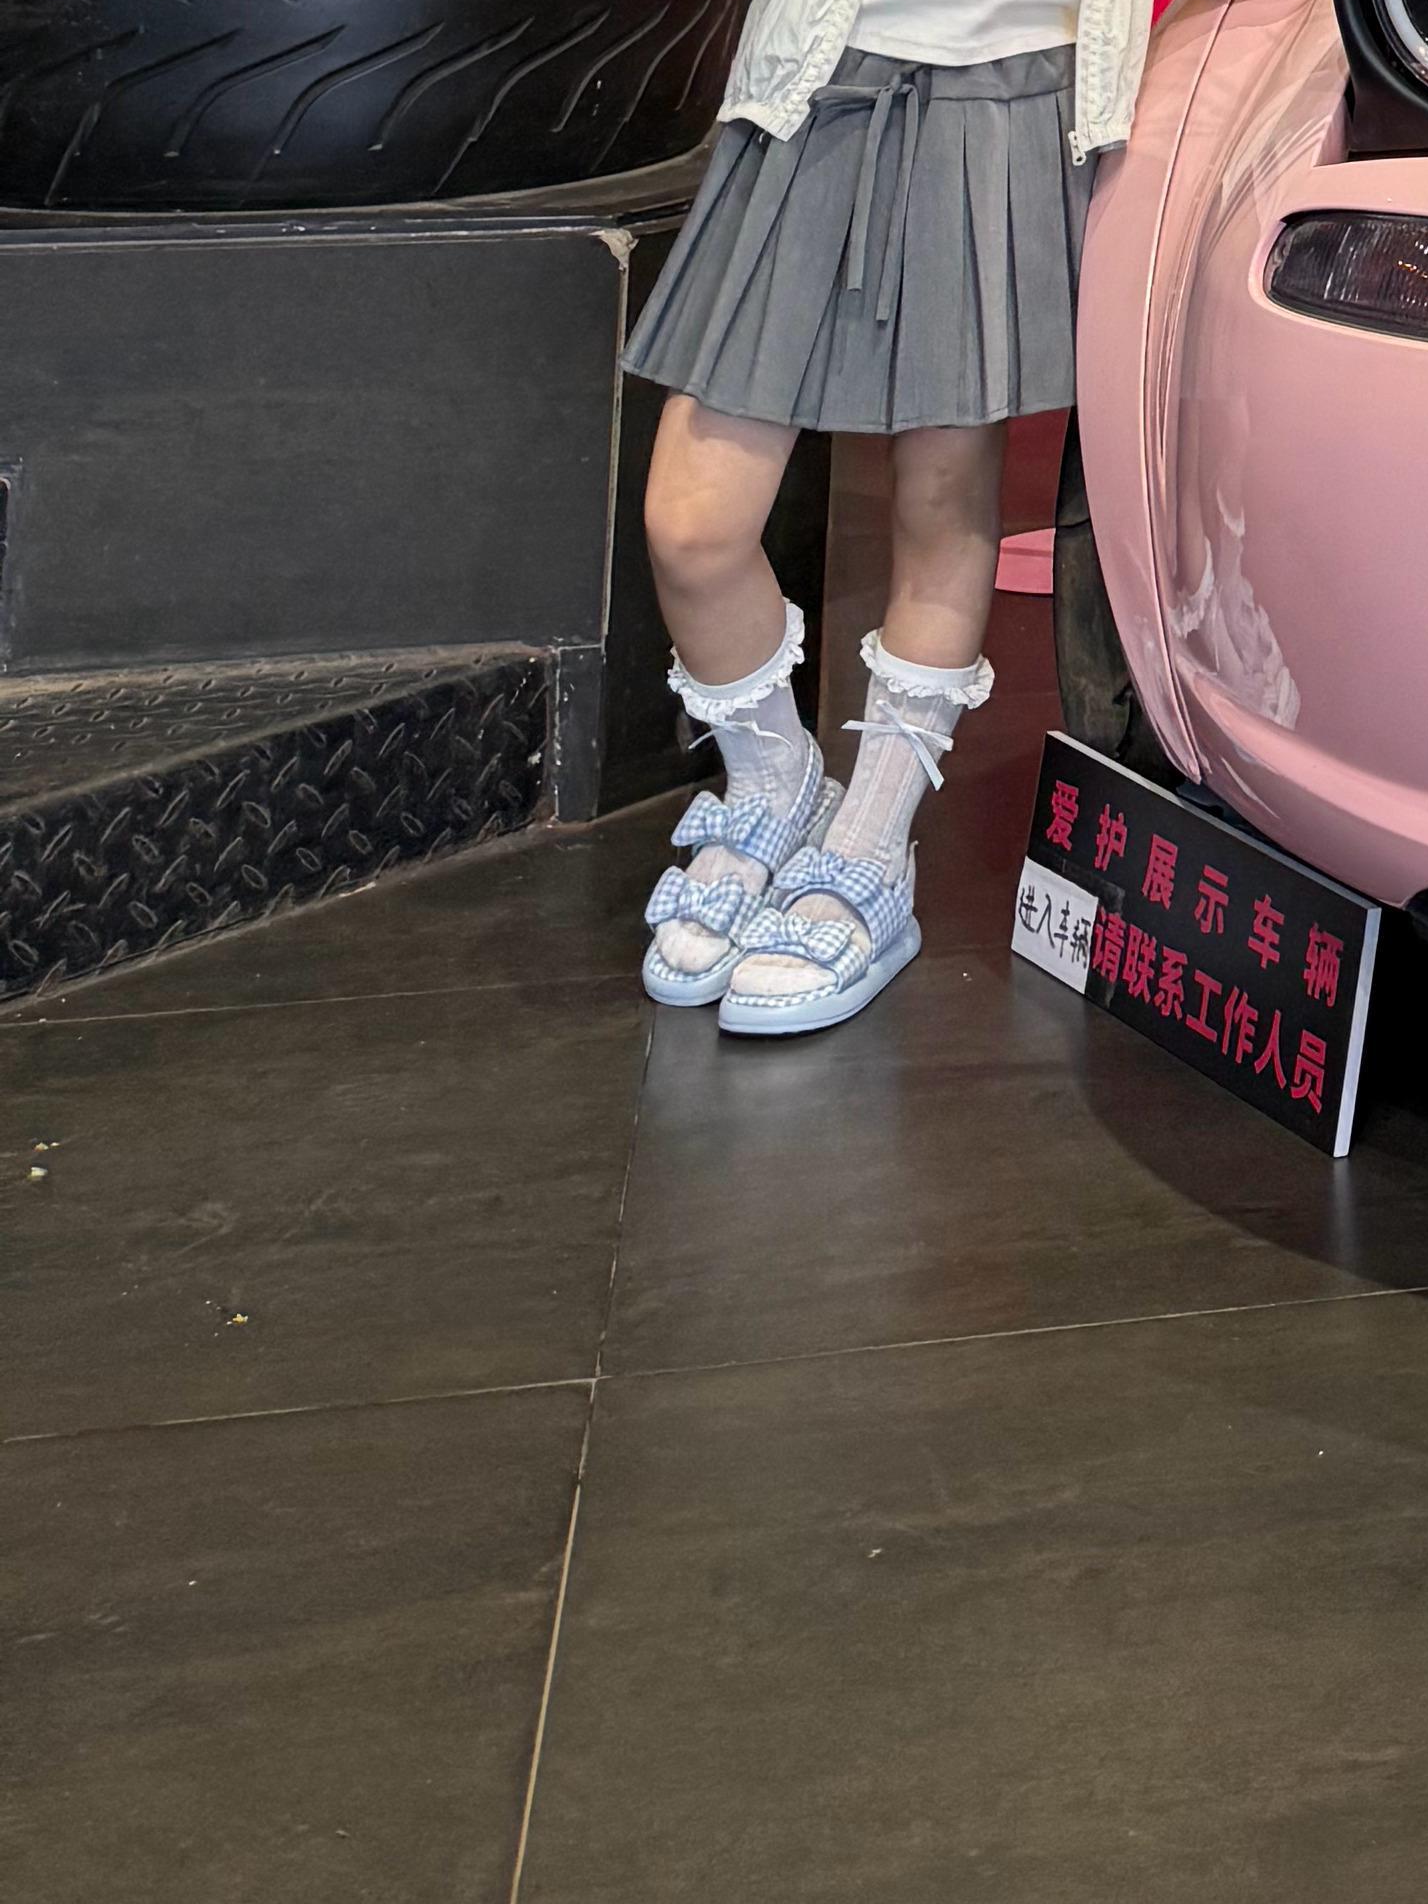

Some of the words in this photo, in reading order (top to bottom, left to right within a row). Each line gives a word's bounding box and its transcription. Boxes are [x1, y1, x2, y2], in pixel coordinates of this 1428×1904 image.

[1045, 780, 1344, 1007] 爱护展示车辆
[1092, 907, 1327, 1114] 请联系工作人员
